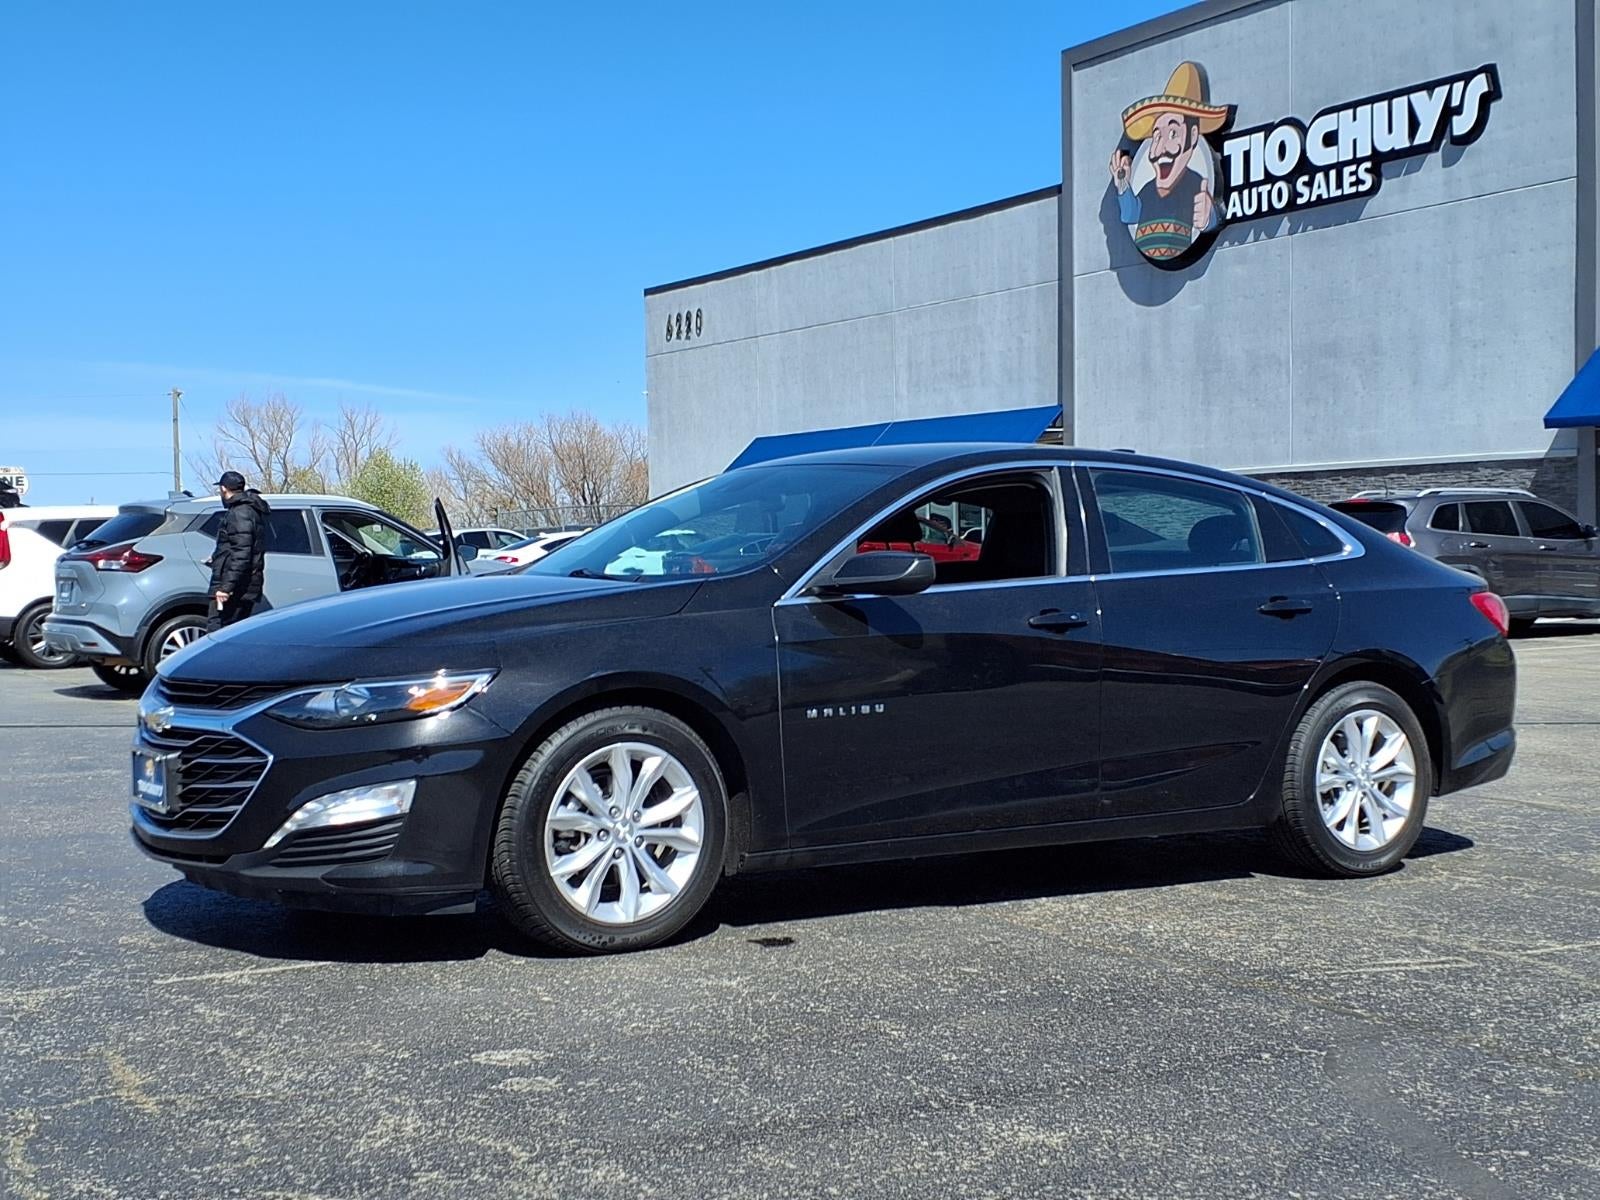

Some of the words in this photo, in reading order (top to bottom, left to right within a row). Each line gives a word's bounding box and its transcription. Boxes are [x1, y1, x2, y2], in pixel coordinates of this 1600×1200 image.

[1224, 125, 1301, 187] TIO
[1305, 72, 1490, 166] CHUY'S
[1225, 180, 1290, 219] AUTO
[1296, 160, 1374, 205] SALES
[666, 308, 702, 342] 6220
[806, 703, 885, 719] MALIBU
